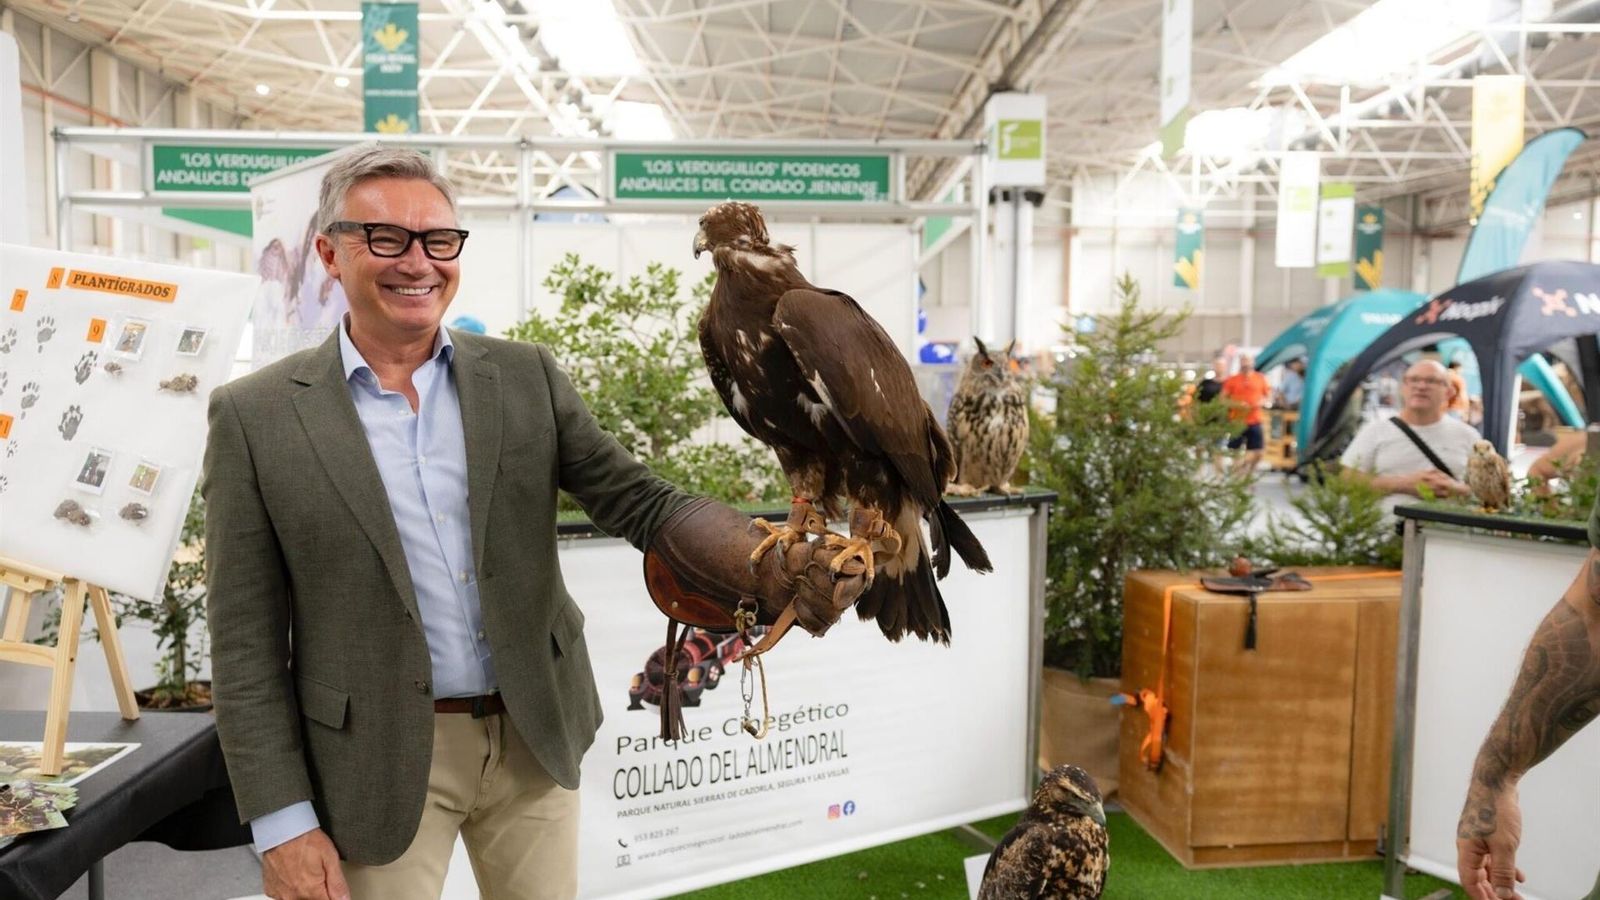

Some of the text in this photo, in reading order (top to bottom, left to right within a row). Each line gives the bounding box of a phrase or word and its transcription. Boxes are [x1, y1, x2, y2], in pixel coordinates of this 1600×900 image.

[157, 170, 239, 186] ANDALUCES
[782, 162, 861, 178] PODENCOS
[619, 177, 700, 192] ANDALUCES
[702, 178, 728, 193] DEL
[729, 178, 806, 194] CONDADO
[73, 274, 171, 298] PLANTÍGRADOS
[93, 324, 101, 337] 9
[616, 703, 849, 756] Parque Cinegético
[613, 729, 848, 800] COLLADO DEL ALMENDRAL
[617, 806, 652, 819] PARQUE
[653, 799, 692, 812] NATURAL
[693, 792, 726, 805] SIERRAS
[727, 790, 738, 799] DE
[777, 775, 806, 789] SEGURA
[813, 771, 827, 781] LAS
[827, 766, 850, 778] VILLAS
